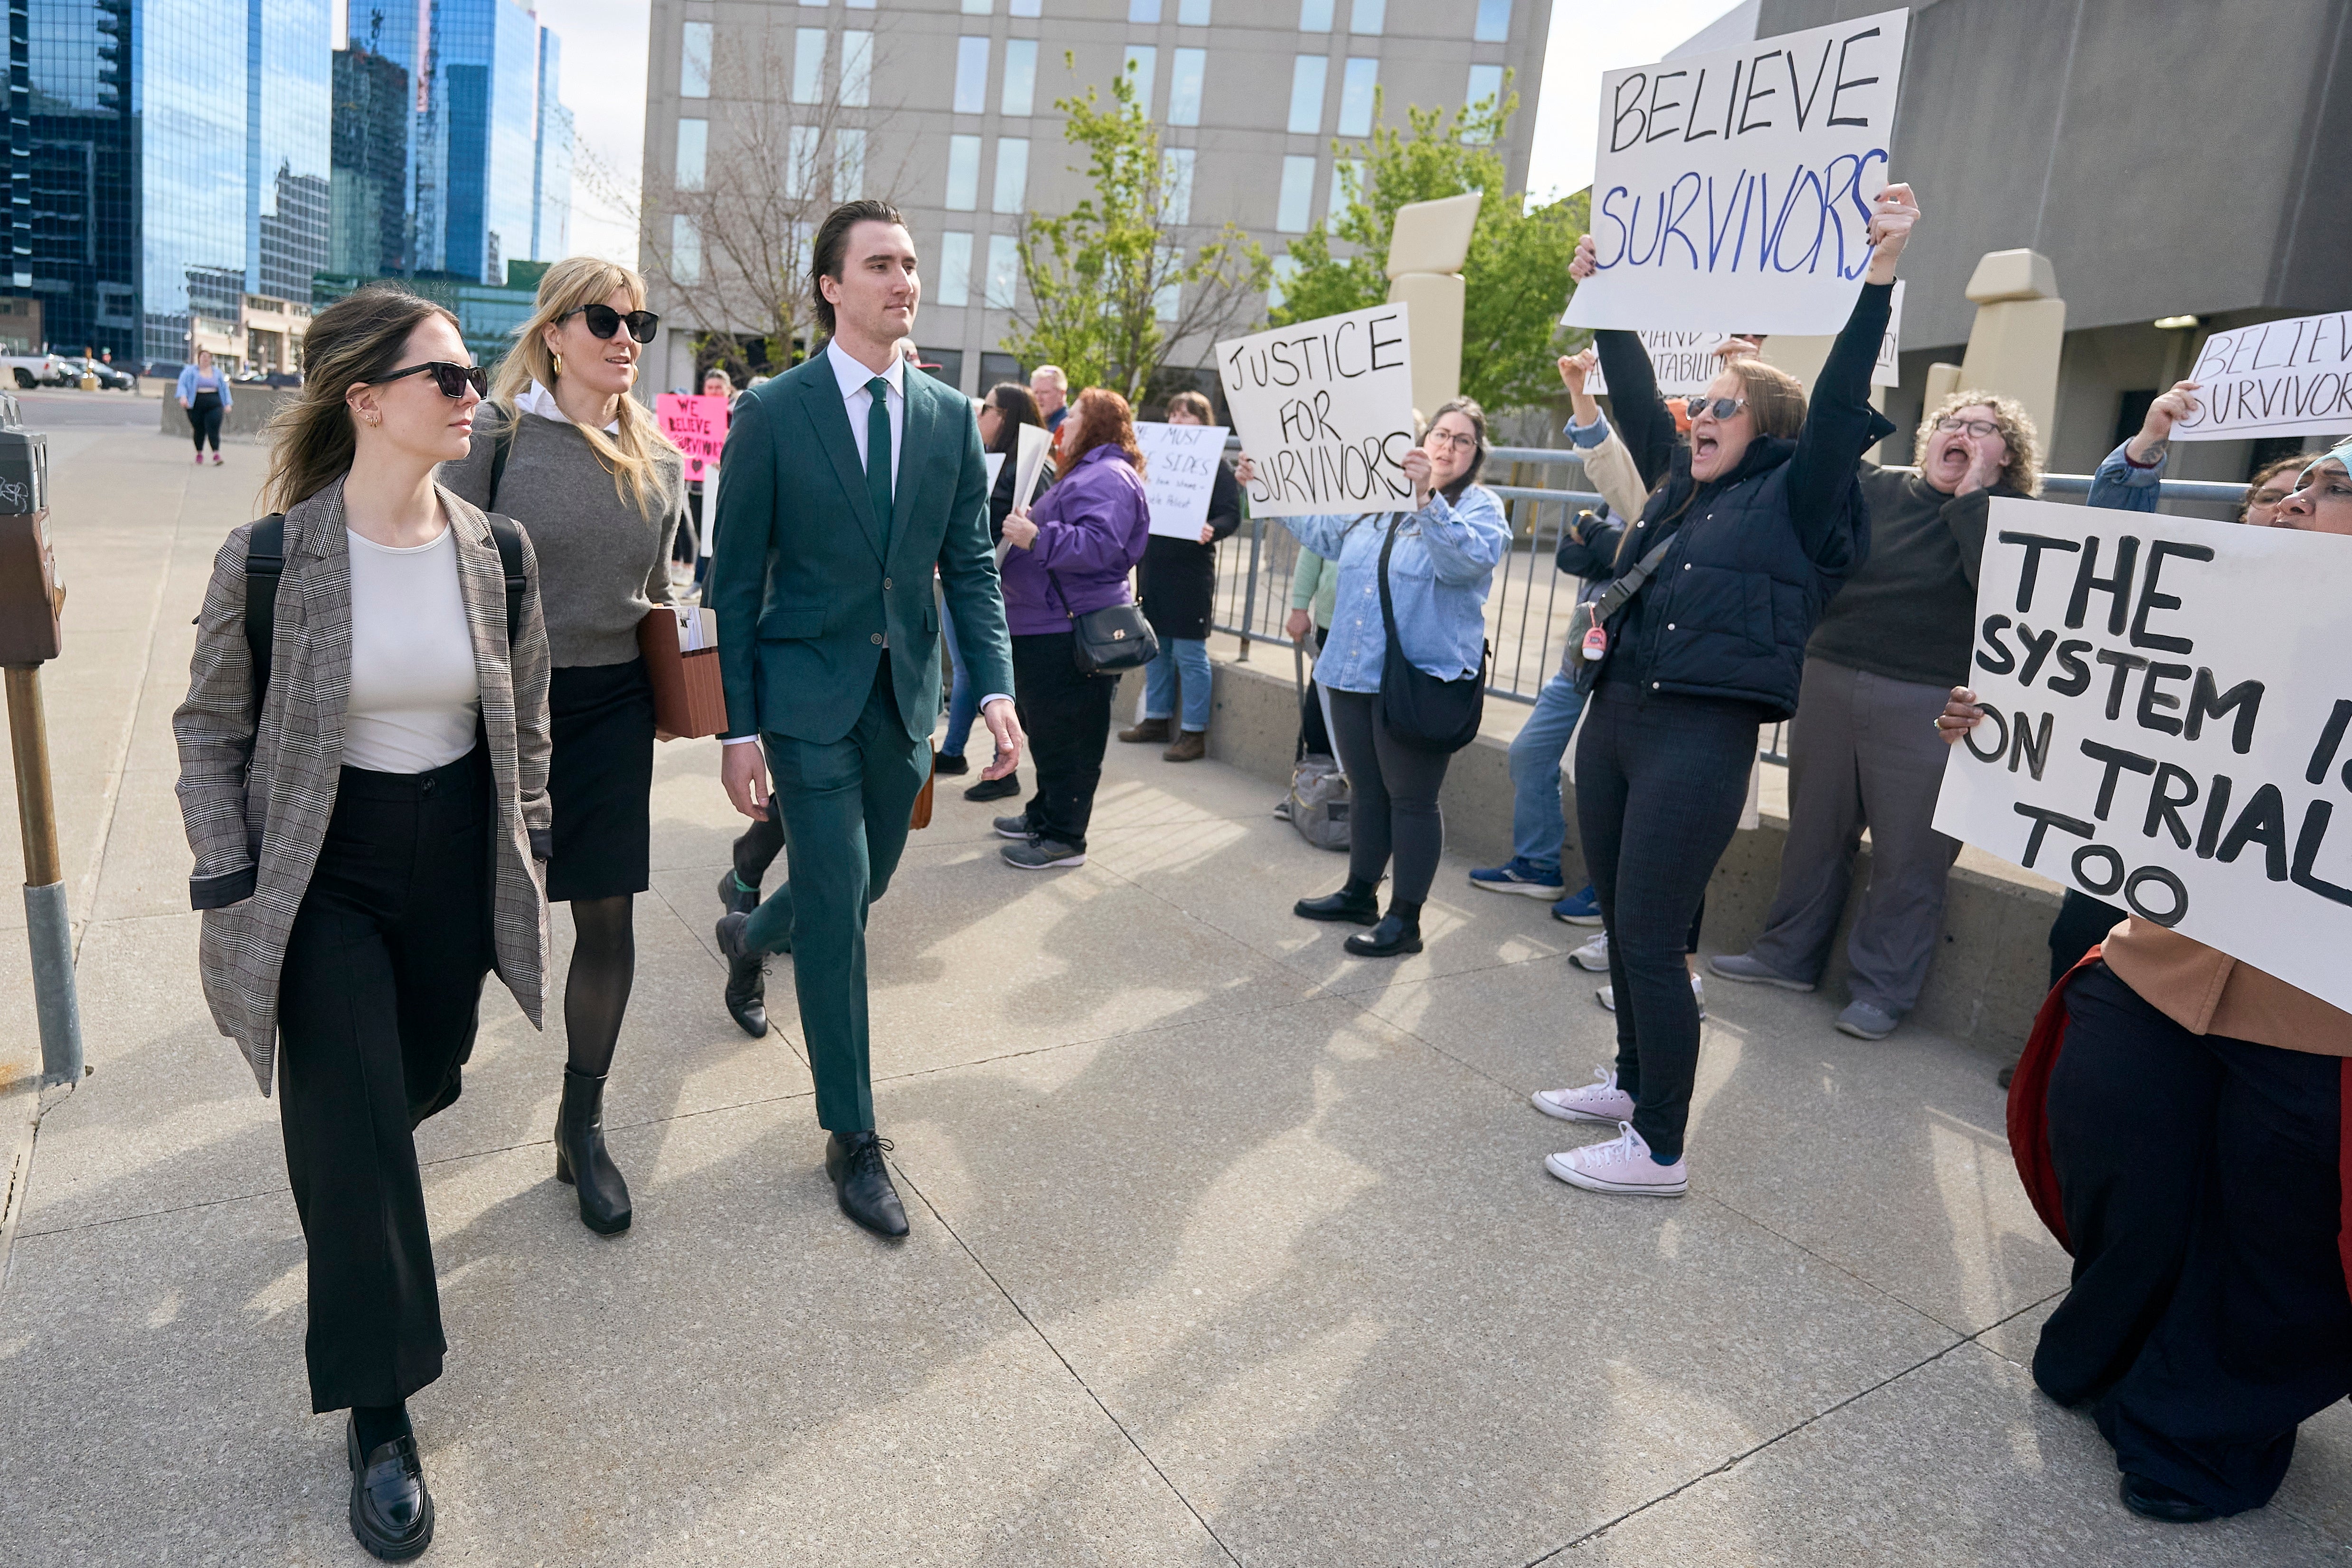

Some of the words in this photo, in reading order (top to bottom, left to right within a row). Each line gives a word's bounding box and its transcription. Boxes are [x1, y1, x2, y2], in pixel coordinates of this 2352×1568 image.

[1610, 27, 1880, 153] BELIEVE
[1595, 148, 1888, 280] SURVIVORS
[1229, 314, 1404, 391] JUSTICE
[669, 417, 711, 435] BELIEVE
[677, 399, 698, 417] WE
[1160, 426, 1208, 445] MUST
[1279, 390, 1342, 444] FOR
[1246, 432, 1413, 504] SURVIVORS
[1998, 529, 2215, 654] THE
[1975, 614, 2265, 754] SYSTEM
[2305, 699, 2352, 794] I
[1963, 702, 2054, 782] ON
[2079, 738, 2352, 908] TRIAL
[2013, 801, 2189, 928] TOO
